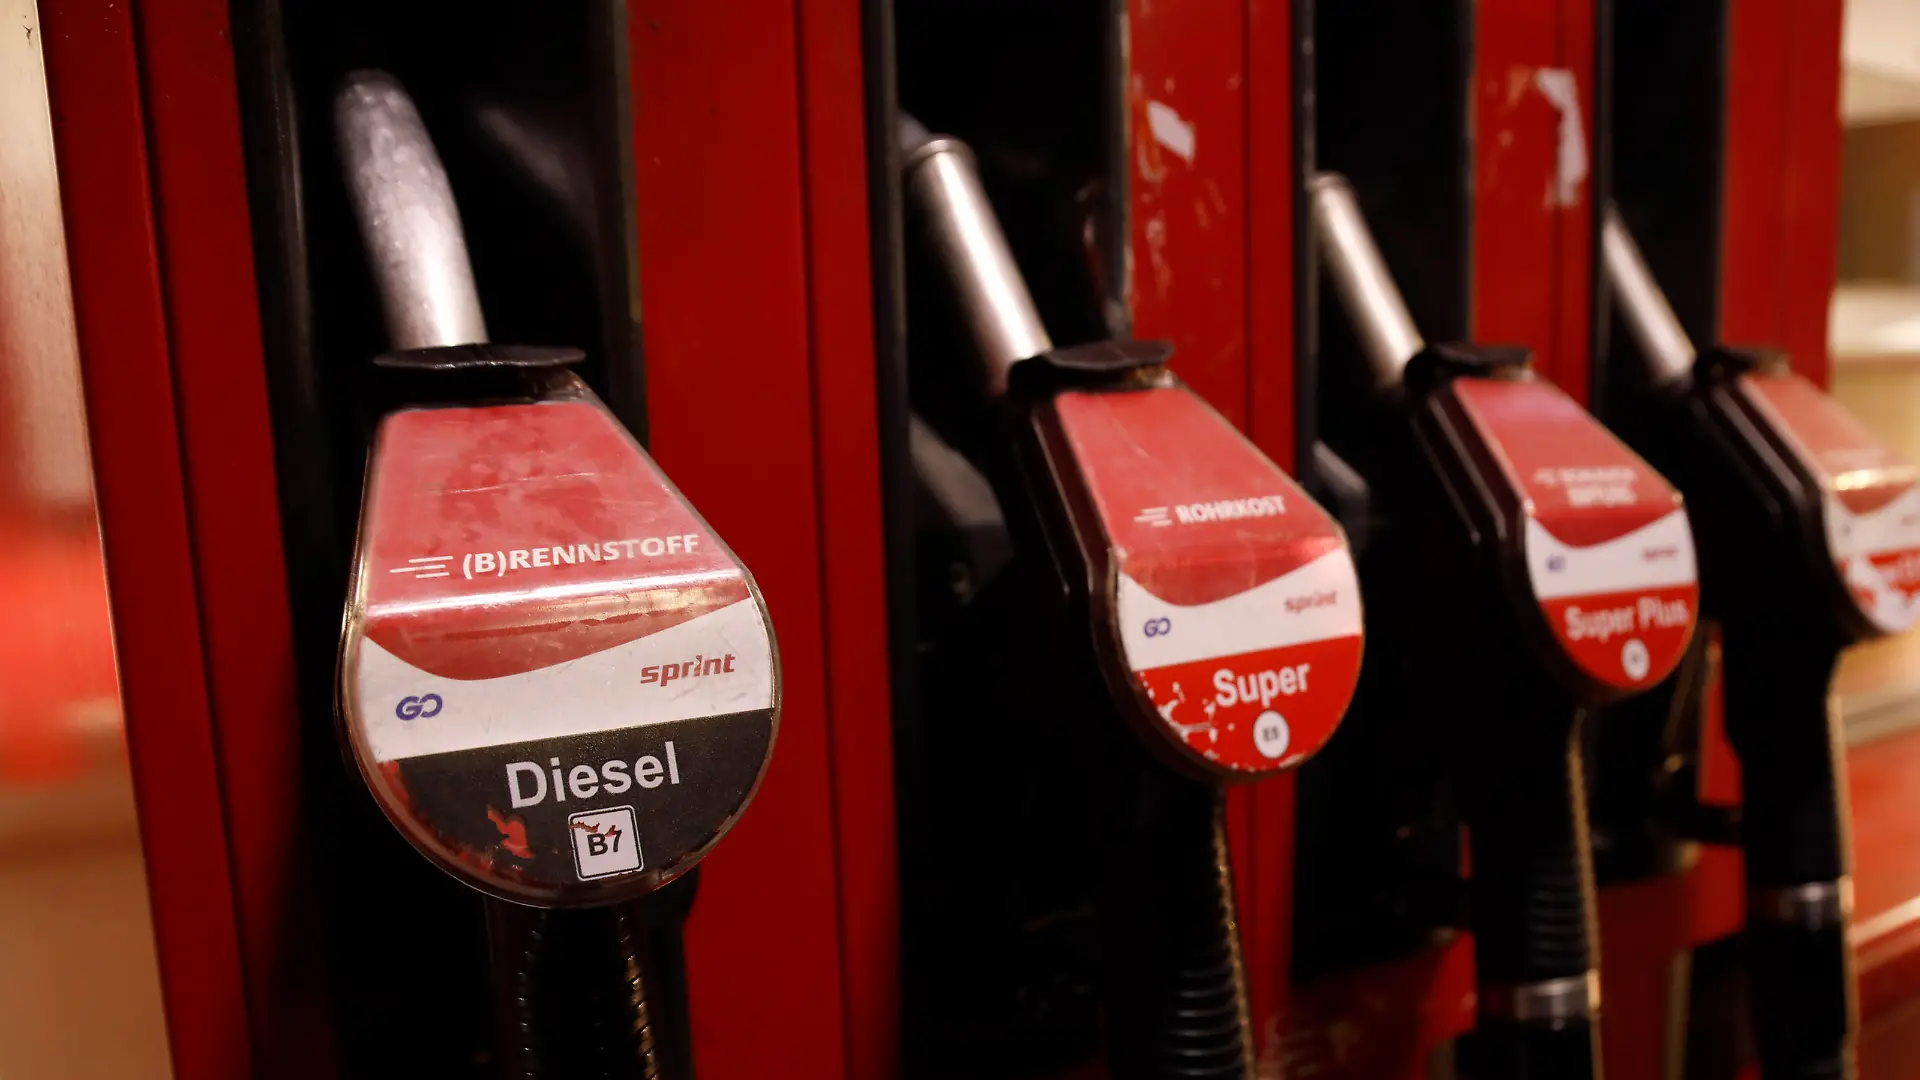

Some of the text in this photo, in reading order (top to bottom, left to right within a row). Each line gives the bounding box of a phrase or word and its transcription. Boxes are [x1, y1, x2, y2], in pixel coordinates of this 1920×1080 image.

[1175, 495, 1286, 524] ROHRKOST
[462, 533, 699, 579] (B)RENNSTOFF
[1284, 591, 1337, 614] sprint
[1565, 597, 1688, 643] Super Plus
[639, 653, 735, 686] sprint
[1213, 662, 1310, 707] Super
[506, 741, 680, 809] Diesel
[586, 829, 623, 856] B7
